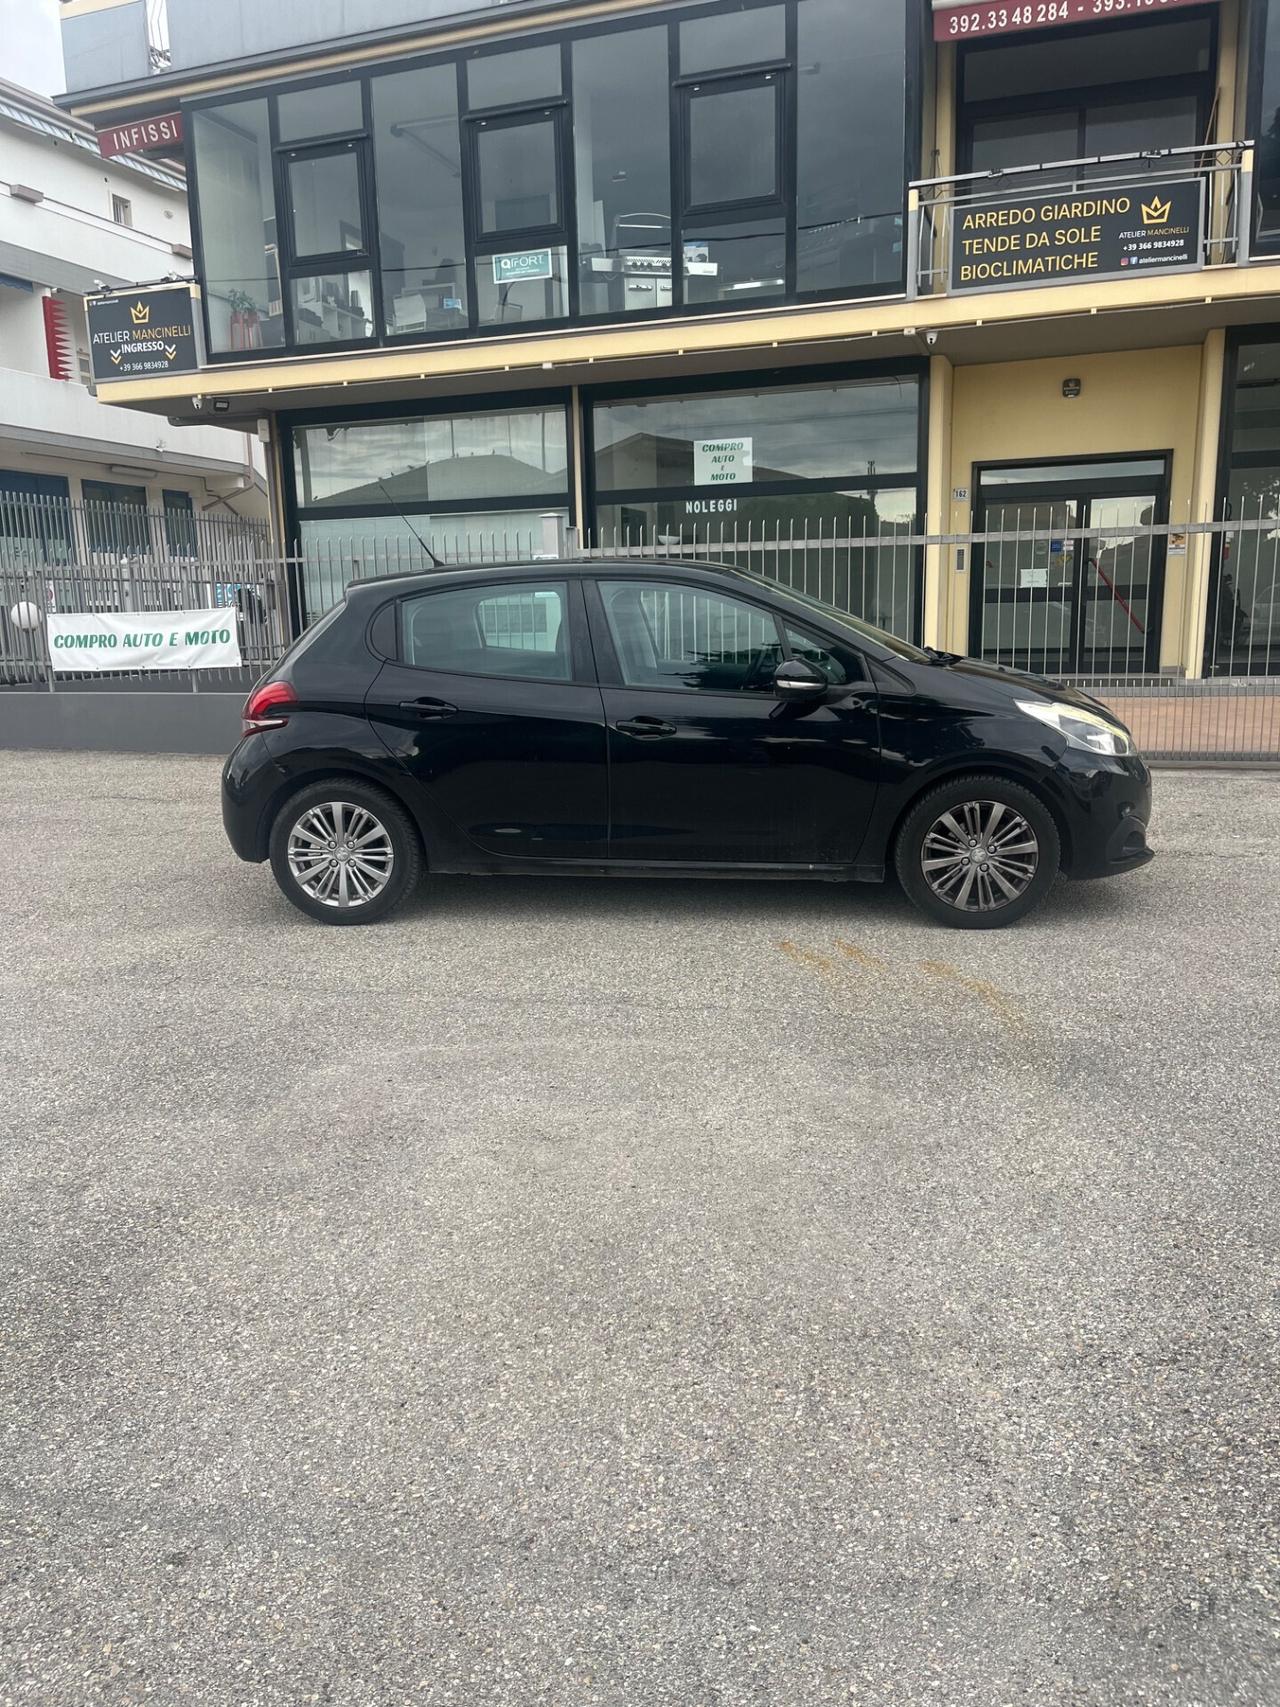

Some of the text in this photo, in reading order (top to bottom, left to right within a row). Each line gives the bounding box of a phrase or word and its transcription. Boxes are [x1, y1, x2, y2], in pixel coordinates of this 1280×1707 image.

[113, 120, 178, 150] INFISSI
[962, 198, 1131, 230] ARREDO GIARDINO
[1119, 226, 1190, 240] ATELIER MANCINELLI
[962, 226, 1102, 255] TENDE DA SOLE
[1123, 239, 1185, 251] +39 366 9834928
[1138, 253, 1189, 264] ateliermancinelli
[960, 252, 1099, 281] BIOCLIMATICHE
[92, 325, 191, 344] ATELIER MANCINELLI
[121, 341, 165, 354] INGRESSO
[120, 360, 169, 372] +39 366 9834928
[702, 442, 744, 453] COMPRO
[711, 454, 736, 464] AUTO
[710, 472, 737, 481] MOTO
[685, 499, 737, 514] NOLEGGI
[54, 629, 231, 649] COMPRO AUTO E MOTO
